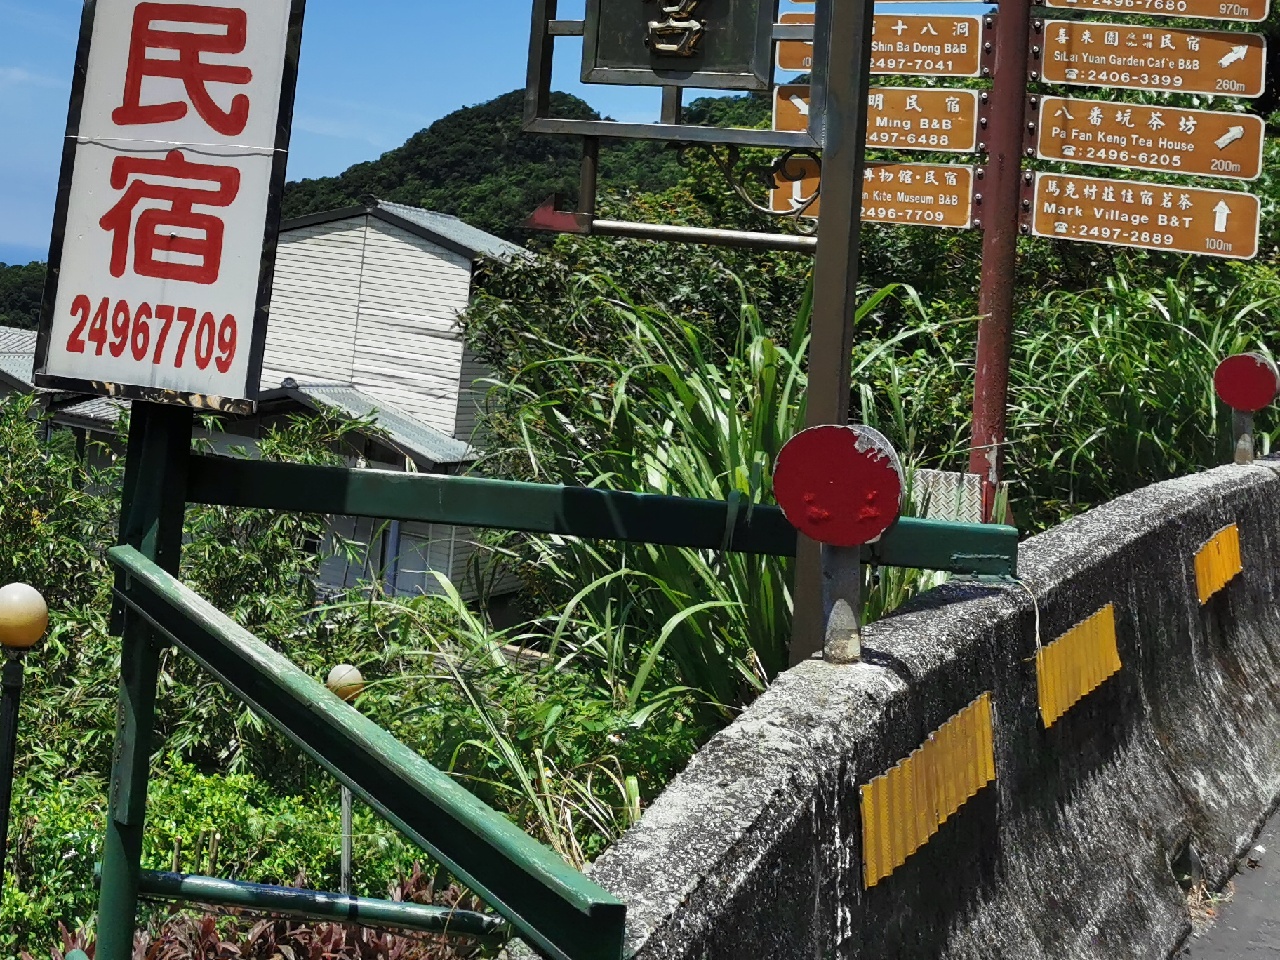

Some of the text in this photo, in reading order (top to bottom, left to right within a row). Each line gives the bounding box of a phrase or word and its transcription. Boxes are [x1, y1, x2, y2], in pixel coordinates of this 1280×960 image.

[1219, 4, 1249, 16] 970m
[871, 41, 967, 56] Shin Ba Dong B&B
[1082, 52, 1106, 64] Yuan
[1109, 54, 1145, 67] Garden
[1178, 59, 1200, 70] B&B
[875, 116, 911, 131] Ming
[919, 118, 953, 130] B&B
[866, 132, 949, 146] 497-6488
[1052, 127, 1195, 152] Pa Fan Keng Tea House
[1211, 159, 1241, 172] 200m
[873, 190, 892, 202] Kite
[896, 191, 934, 205] Museum
[938, 194, 958, 206] B&B
[1044, 203, 1193, 229] Mark Village B&T
[1205, 238, 1233, 253] 100m
[66, 294, 238, 374] 24967709
